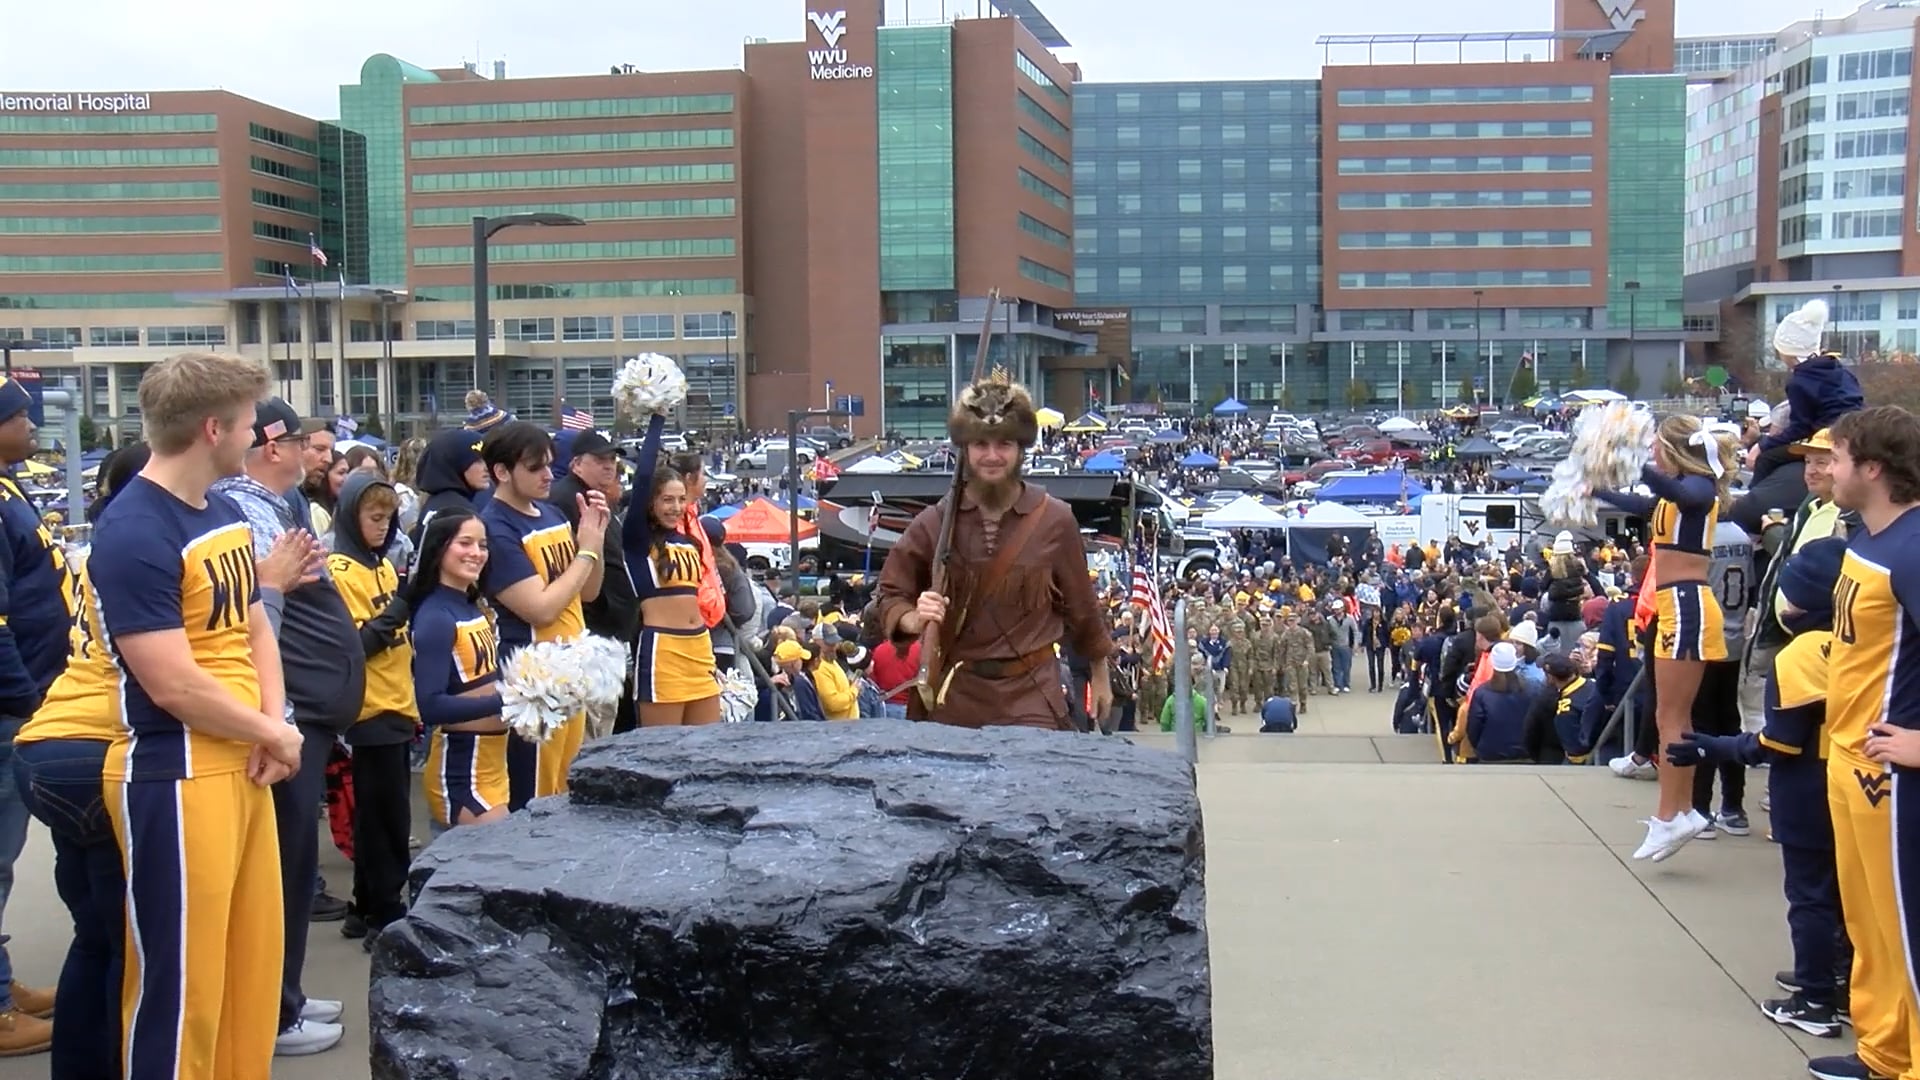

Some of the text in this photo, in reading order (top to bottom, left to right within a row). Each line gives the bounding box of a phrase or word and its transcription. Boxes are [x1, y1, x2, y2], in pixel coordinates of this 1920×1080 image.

[808, 49, 847, 65] WVU
[810, 65, 873, 80] Medicine
[0, 92, 151, 114] emorial Hospital
[1723, 566, 1745, 611] 0
